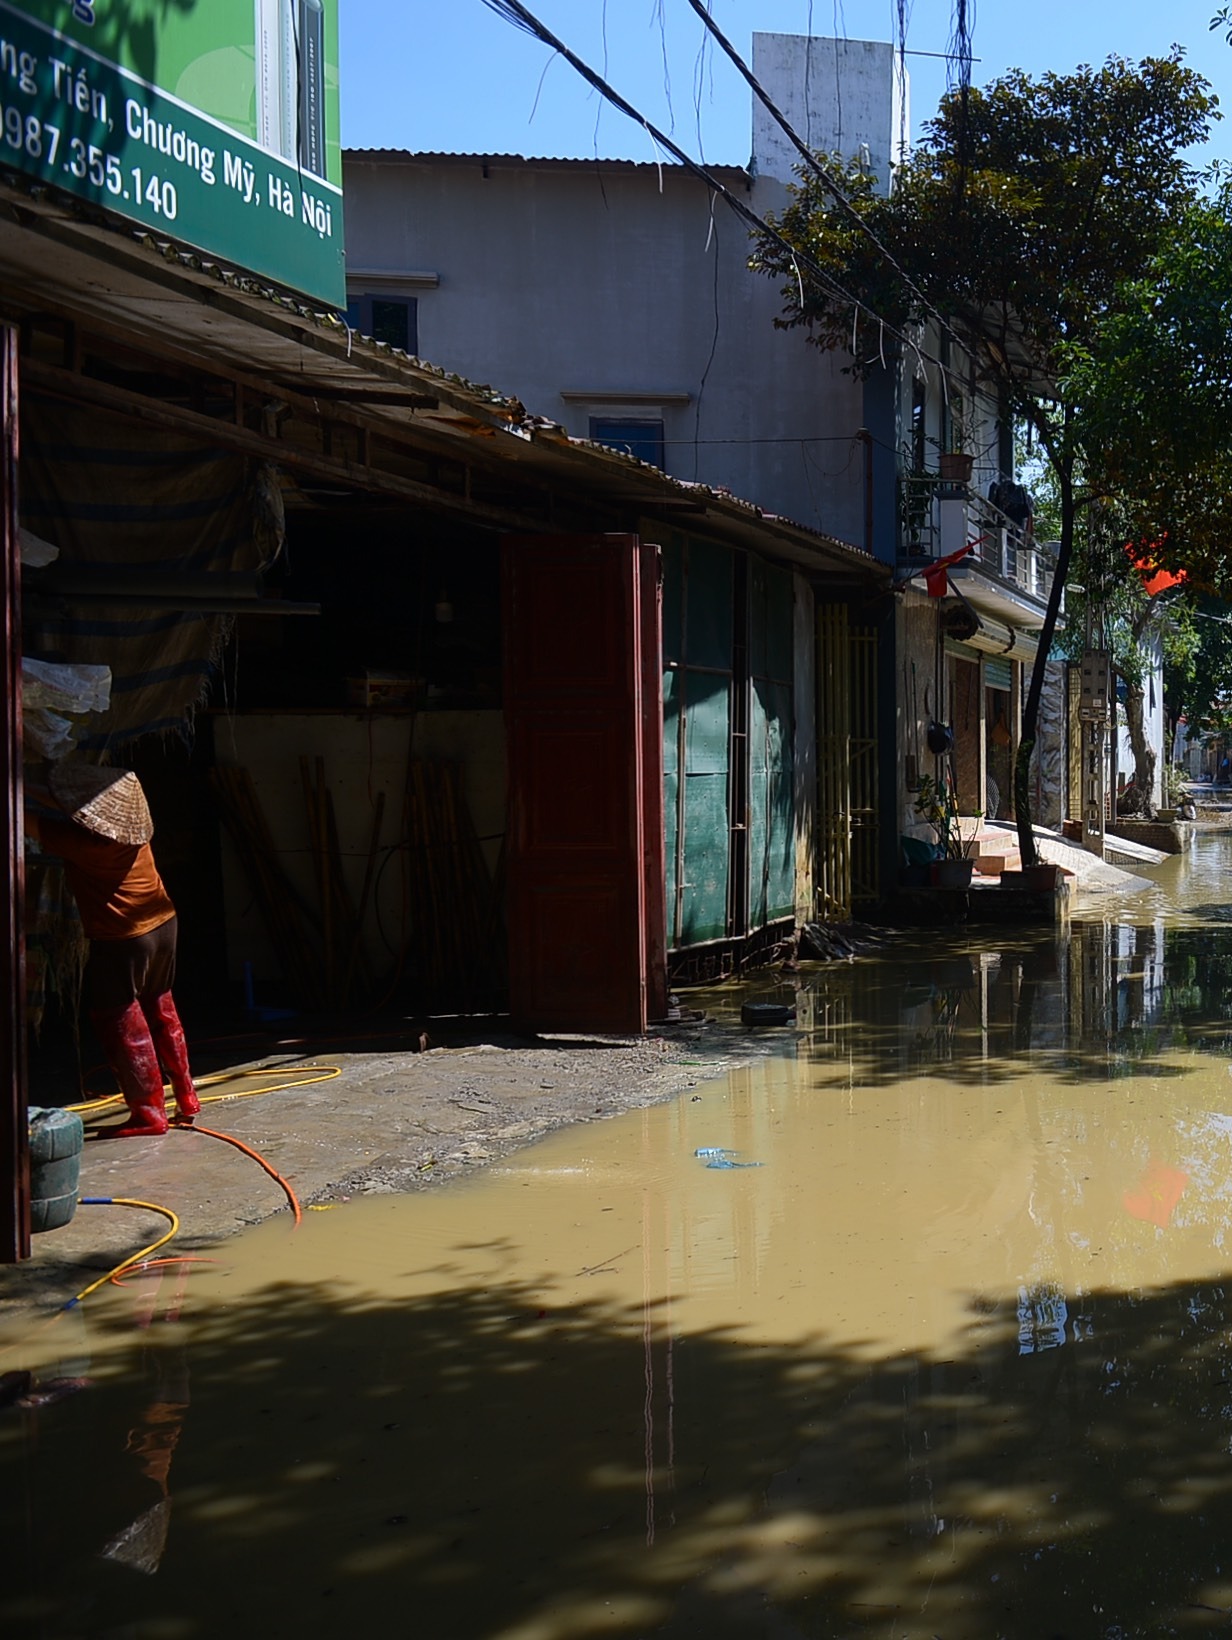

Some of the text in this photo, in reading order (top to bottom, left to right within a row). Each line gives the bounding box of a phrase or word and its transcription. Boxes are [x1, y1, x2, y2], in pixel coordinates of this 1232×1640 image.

[0, 103, 177, 221] 987.355.140
[48, 56, 114, 133] Tiến,
[125, 98, 216, 185] Chương
[223, 149, 260, 207] Mỹ,
[268, 173, 294, 218] Hà
[302, 191, 332, 239] Nội
